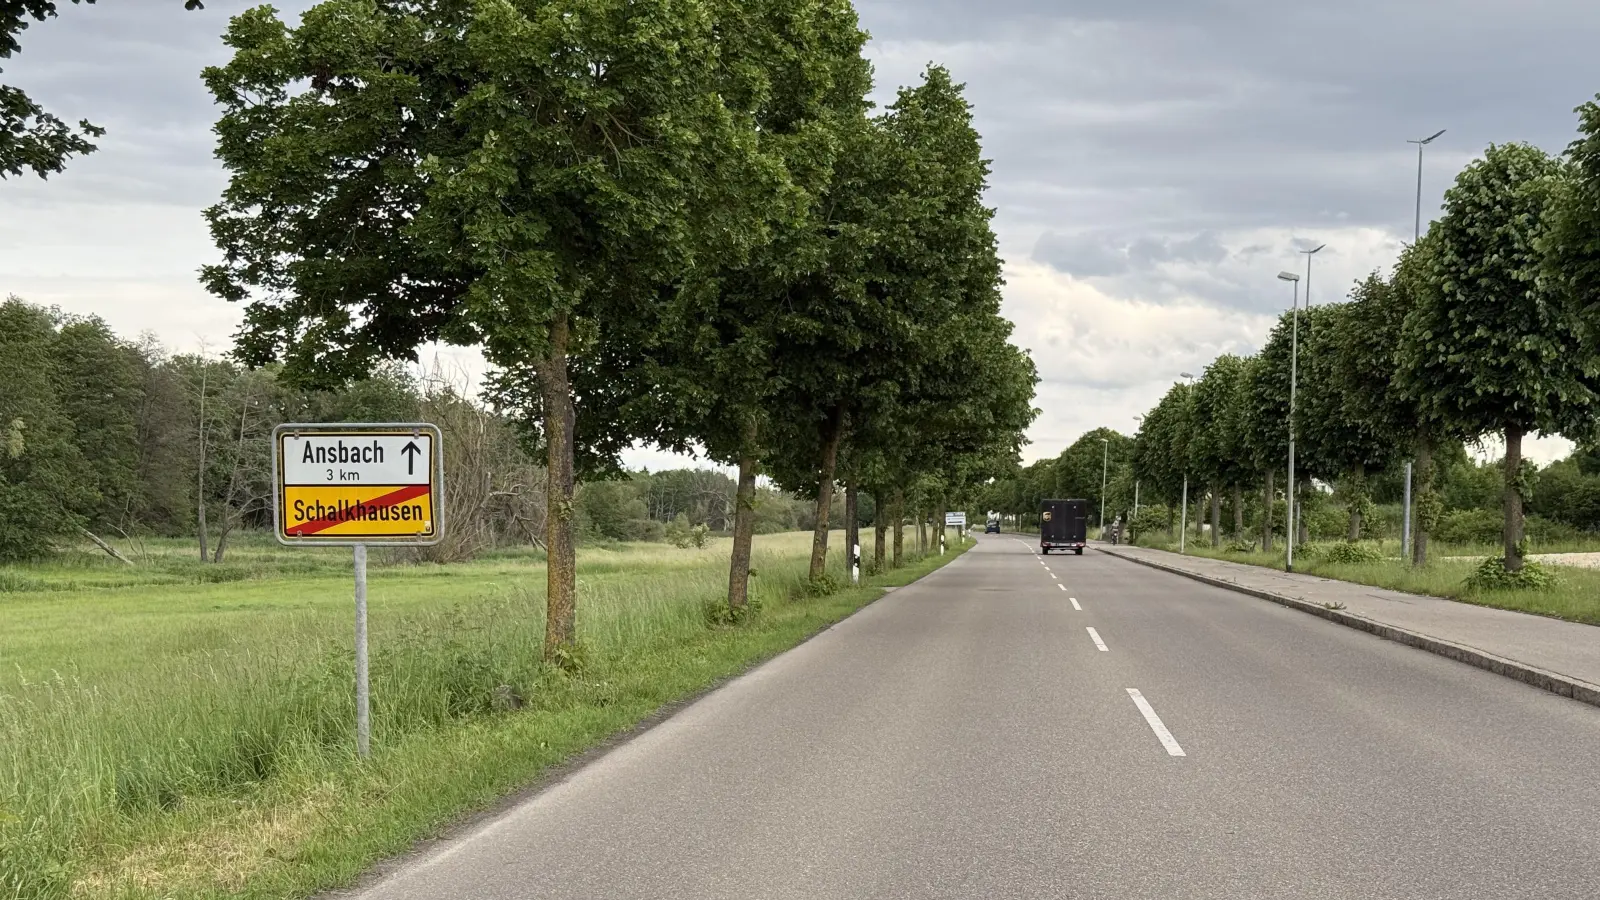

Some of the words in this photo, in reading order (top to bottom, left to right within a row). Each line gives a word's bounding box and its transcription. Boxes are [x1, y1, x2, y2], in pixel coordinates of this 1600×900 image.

[302, 440, 384, 463] Ansbach
[326, 469, 334, 481] 3
[340, 469, 360, 481] km
[293, 499, 423, 522] Schalkhausen
